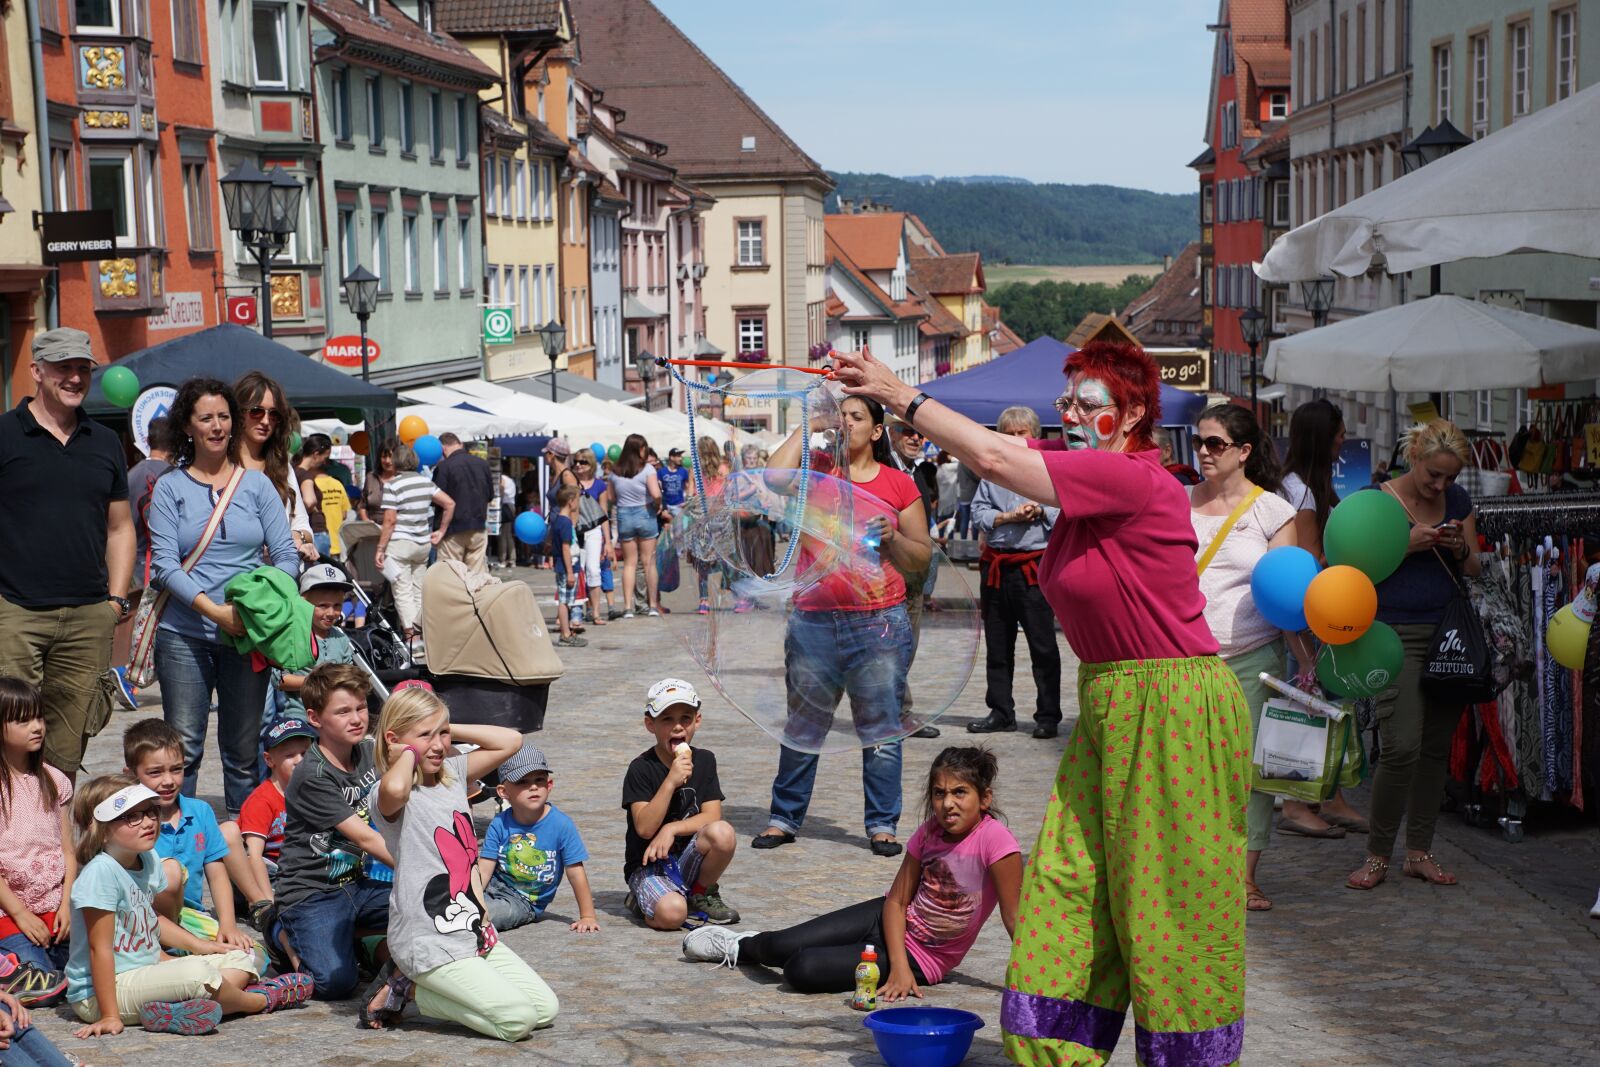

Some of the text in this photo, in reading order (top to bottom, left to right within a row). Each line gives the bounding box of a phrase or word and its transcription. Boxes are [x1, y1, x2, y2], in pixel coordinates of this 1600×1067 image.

[47, 239, 113, 252] GERRY WEBER
[235, 302, 251, 320] G
[1160, 360, 1202, 382] to go!
[1439, 628, 1467, 653] Ja,
[1429, 661, 1474, 674] ZEITUNG
